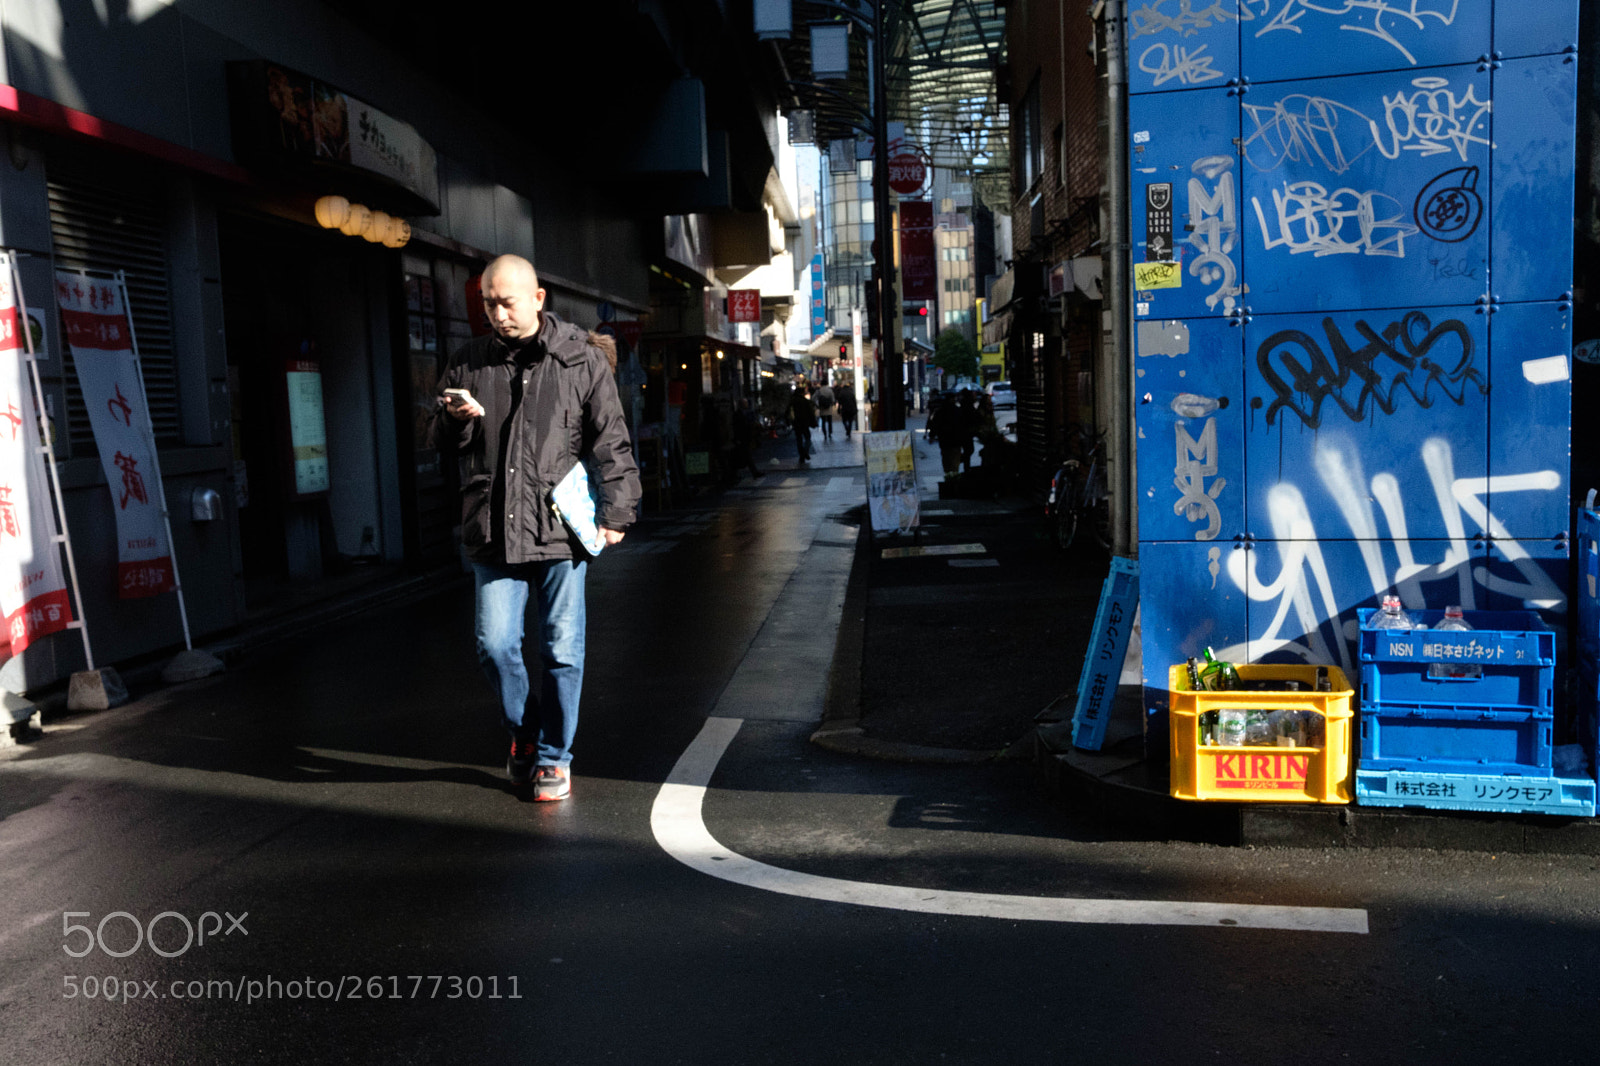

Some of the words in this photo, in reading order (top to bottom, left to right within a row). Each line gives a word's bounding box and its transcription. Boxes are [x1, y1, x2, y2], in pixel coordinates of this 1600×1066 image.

[888, 165, 923, 182] 消火栓
[1389, 643, 1413, 657] NSN
[1086, 673, 1108, 720] 株式会社
[1100, 602, 1123, 660] リンクモア
[1215, 755, 1309, 779] KIRIN
[1244, 781, 1278, 789] キリンビール
[1395, 780, 1456, 797] 株式会社
[1474, 784, 1553, 801] リンクモア
